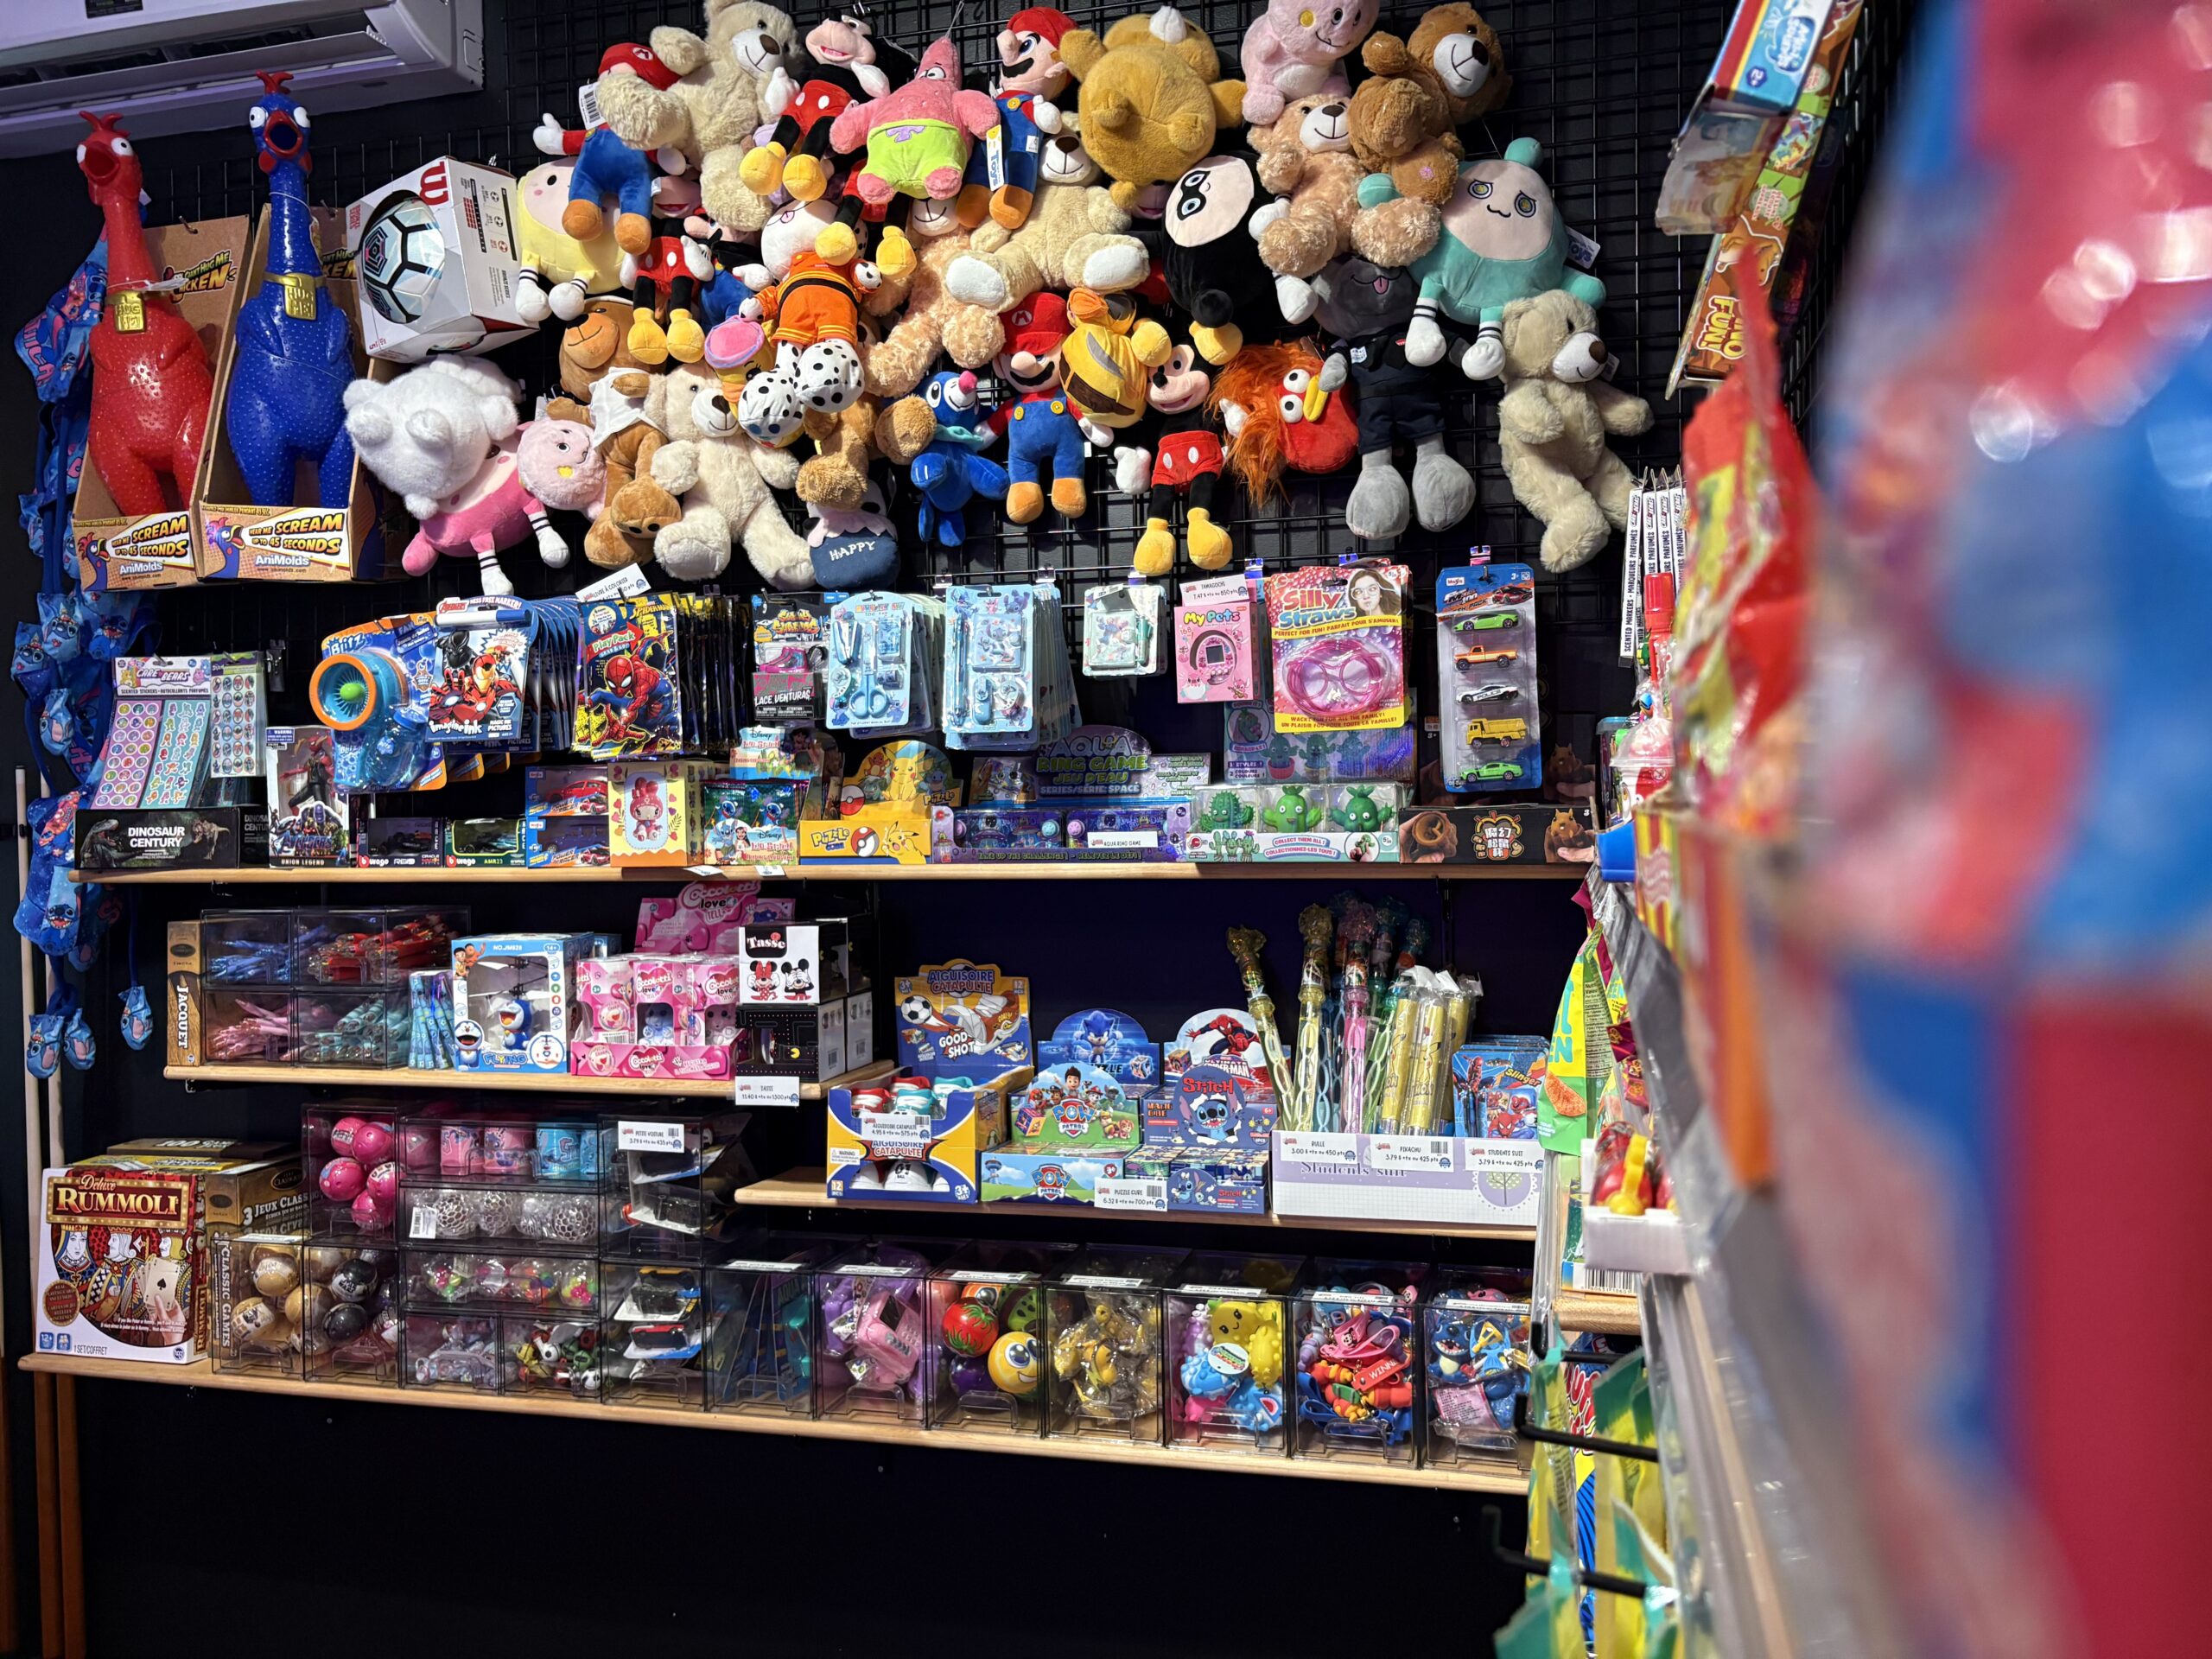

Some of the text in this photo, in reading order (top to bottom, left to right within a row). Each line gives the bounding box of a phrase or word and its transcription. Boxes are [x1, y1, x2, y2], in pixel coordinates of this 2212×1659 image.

[990, 149, 1000, 187] Toys
[184, 250, 231, 280] GIANT HUG ME
[288, 286, 315, 302] HUG
[116, 302, 142, 315] HUG
[1700, 298, 1735, 350] FUN!
[121, 514, 188, 545] ME SCREAM
[248, 512, 346, 537] HEAR ME SCREAM
[128, 538, 188, 558] 45 SECONDS
[269, 537, 341, 555] 45 SECONDS
[830, 541, 876, 562] HAPPY
[1647, 531, 1656, 560] PARFUMÉS
[1661, 531, 1670, 560] PARFUMÉS
[118, 561, 164, 575] AniMolds
[254, 554, 311, 567] AniMolds
[593, 588, 606, 599] LIVRE
[608, 576, 628, 593] COLORIER
[1201, 582, 1225, 590] TAMAGOCHI
[1624, 529, 1638, 653] SCENTED MARKERS MARQUEURS PARFUMÉS
[1282, 588, 1344, 610] Silly
[1184, 608, 1240, 626] My Pets
[1279, 607, 1357, 629] Straws
[1326, 622, 1351, 632] PARFAIT
[593, 632, 636, 653] Play Pack
[137, 669, 189, 682] CARE BEARS
[429, 718, 483, 735] imagine ink
[1370, 716, 1398, 725] FAMILLE!
[750, 730, 772, 740] Disney
[1050, 735, 1133, 757] AQUA
[1037, 755, 1148, 772] RING GAME
[1053, 772, 1129, 785] JEU D'EAU
[1108, 785, 1140, 793] SPACE
[127, 826, 186, 838] DINOSAUR
[757, 830, 783, 841] Disney
[130, 837, 183, 849] CENTURY
[1265, 847, 1313, 856] COLLECTIONNEZ-LES
[700, 899, 727, 909] love
[747, 936, 786, 950] Tasse
[928, 969, 994, 982] AIGUISOIRE
[931, 980, 992, 994] CATAPULTE
[175, 984, 189, 1049] JACQUET
[939, 1032, 968, 1048] GOOD
[948, 1042, 976, 1058] SHOT
[483, 1052, 528, 1065] FLYING
[1504, 1068, 1541, 1087] Slinger
[874, 1147, 922, 1158] CATAPULTE
[1301, 1161, 1369, 1175] Students
[79, 1174, 116, 1192] Deluxe
[831, 1181, 842, 1190] 12
[955, 1185, 969, 1194] 3+
[56, 1186, 180, 1216] RUMMOLI
[243, 1206, 253, 1226] 3
[253, 1200, 277, 1217] JEUX
[221, 1248, 232, 1347] CLASSIC GAMES
[197, 1288, 207, 1351] RUMMOLI
[41, 1333, 53, 1343] 12+
